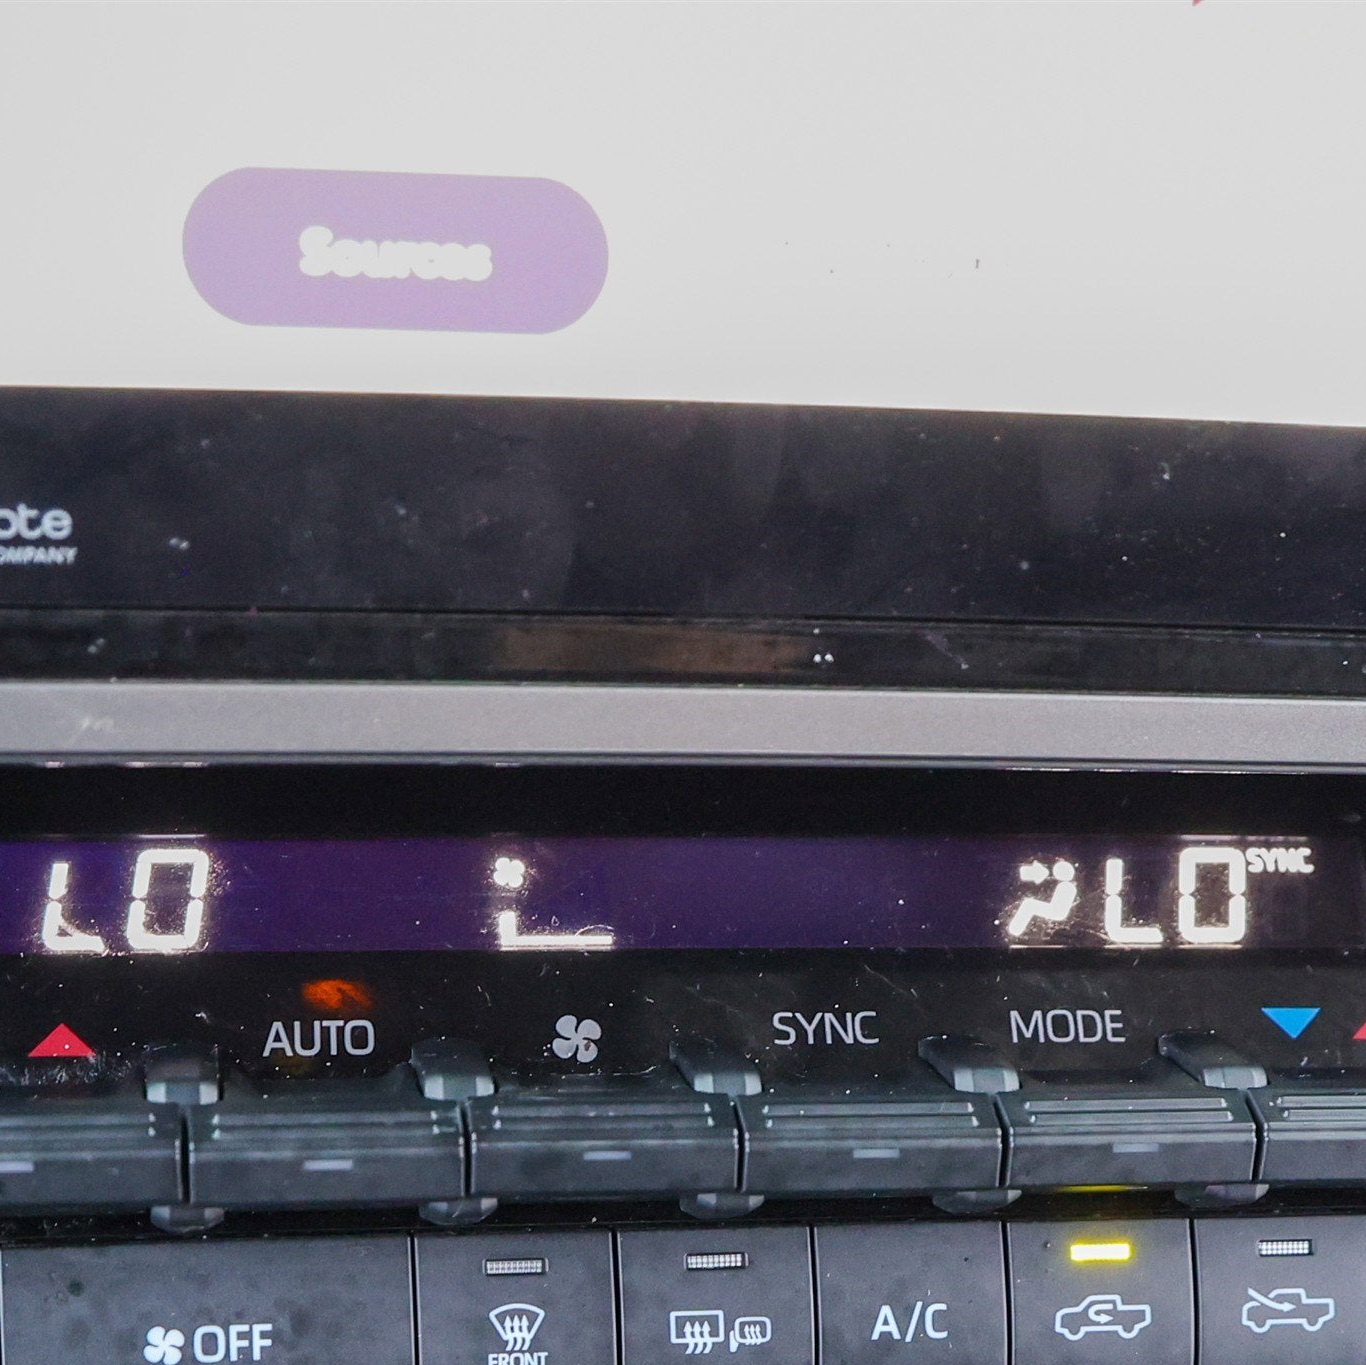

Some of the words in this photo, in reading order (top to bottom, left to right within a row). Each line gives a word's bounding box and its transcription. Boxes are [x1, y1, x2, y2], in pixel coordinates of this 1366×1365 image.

[1245, 847, 1315, 875] SYNC
[41, 847, 211, 954] LO
[1102, 846, 1247, 945] LO
[263, 1019, 375, 1057] AUTO
[772, 1010, 880, 1046] SYNC
[1009, 1009, 1126, 1044] MODE
[871, 1300, 949, 1343] A/C
[193, 1323, 273, 1363] OFF
